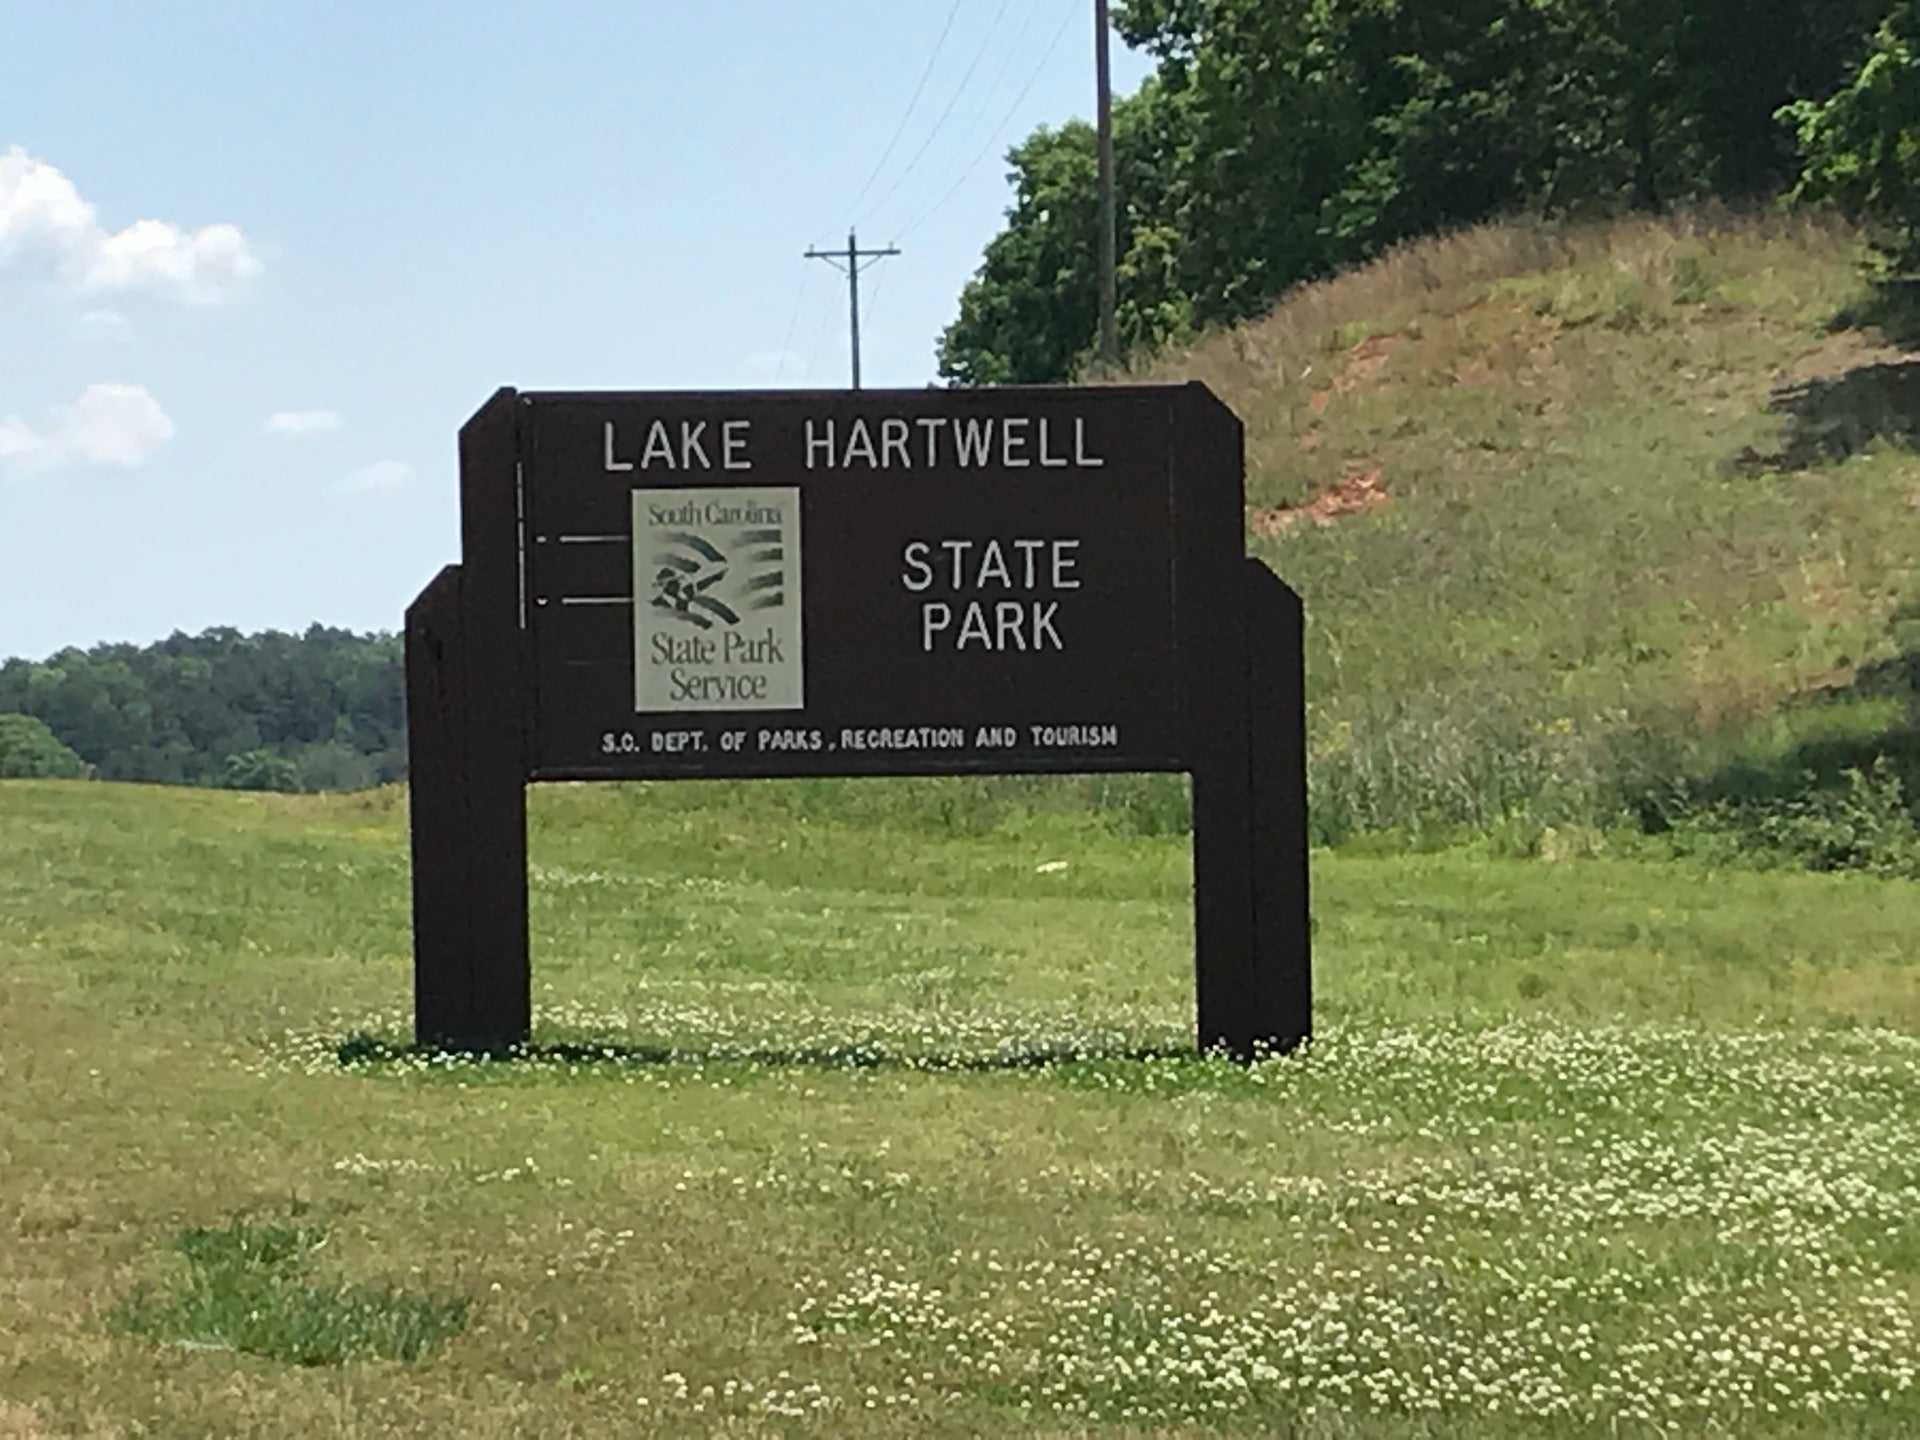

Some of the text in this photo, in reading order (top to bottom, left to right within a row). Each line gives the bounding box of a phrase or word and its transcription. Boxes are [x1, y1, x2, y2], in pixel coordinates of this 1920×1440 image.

[603, 417, 1105, 472] LAKE HARTWELL
[649, 501, 781, 526] South Carolina
[902, 539, 1081, 591] STATE
[922, 602, 1064, 651] PARK
[651, 628, 784, 665] State Park
[670, 668, 766, 701] Service
[651, 731, 708, 753] DEPT.
[720, 731, 747, 751] OF
[841, 727, 965, 749] RECREATION
[974, 726, 1017, 747] AND
[1031, 724, 1118, 747] TOURISM
